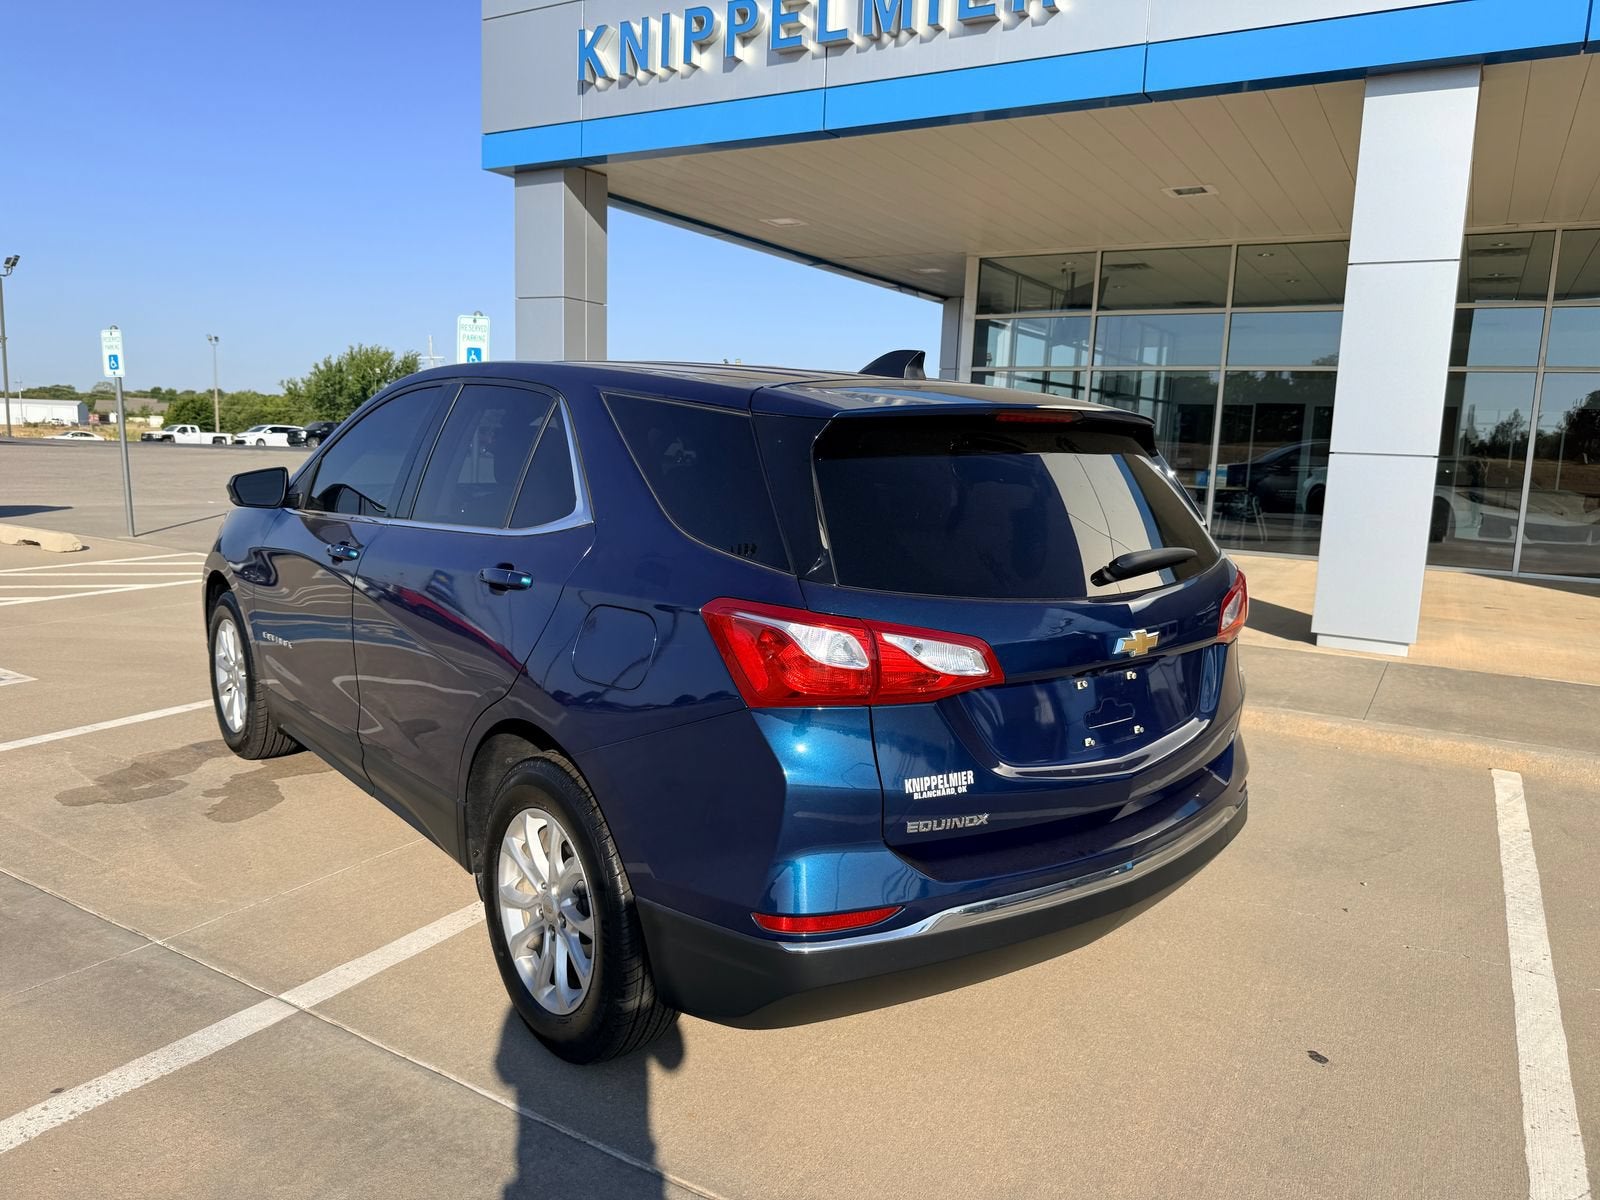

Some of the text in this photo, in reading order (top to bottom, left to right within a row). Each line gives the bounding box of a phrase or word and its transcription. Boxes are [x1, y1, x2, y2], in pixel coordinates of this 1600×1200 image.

[578, 0, 1056, 82] KNIPPELM
[904, 770, 974, 793] KNIPPELMIER
[913, 787, 957, 799] BLANCHARD,
[906, 812, 989, 833] EQUINOX
